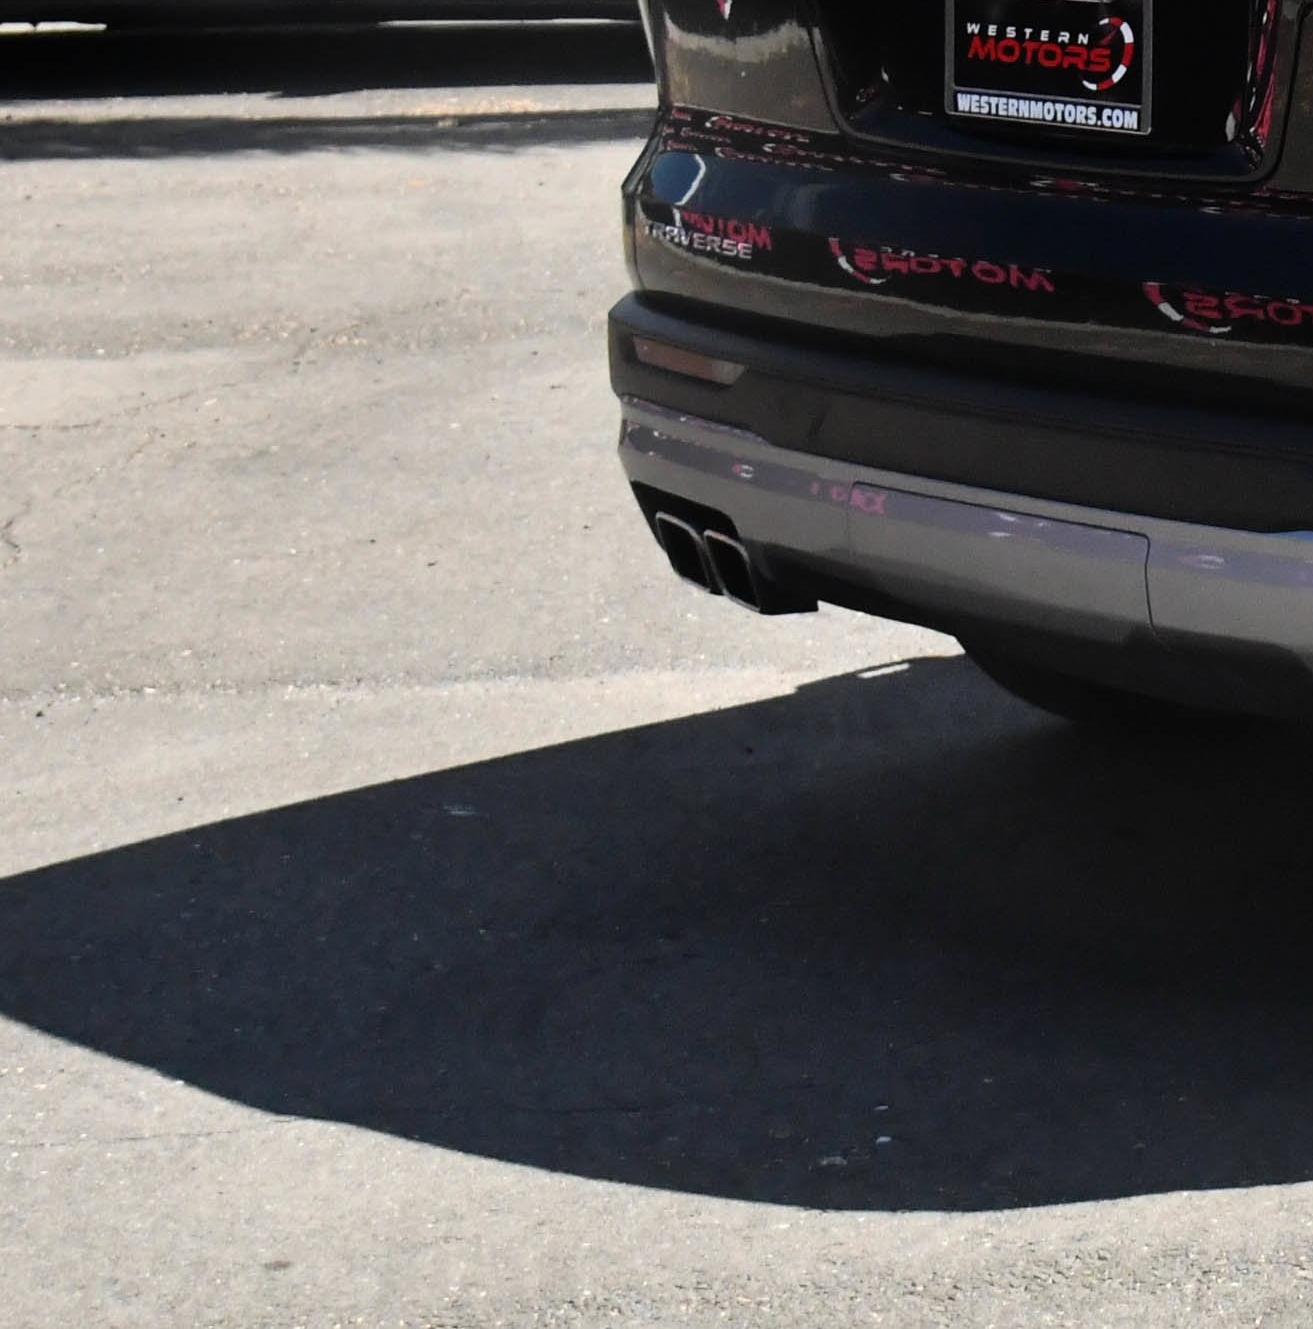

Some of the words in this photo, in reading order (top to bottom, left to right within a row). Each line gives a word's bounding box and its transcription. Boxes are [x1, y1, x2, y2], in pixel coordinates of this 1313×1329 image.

[966, 22, 1089, 45] WESTERN
[967, 36, 1112, 73] MOTORS
[956, 92, 1139, 130] WESTERNMOTORS.COM
